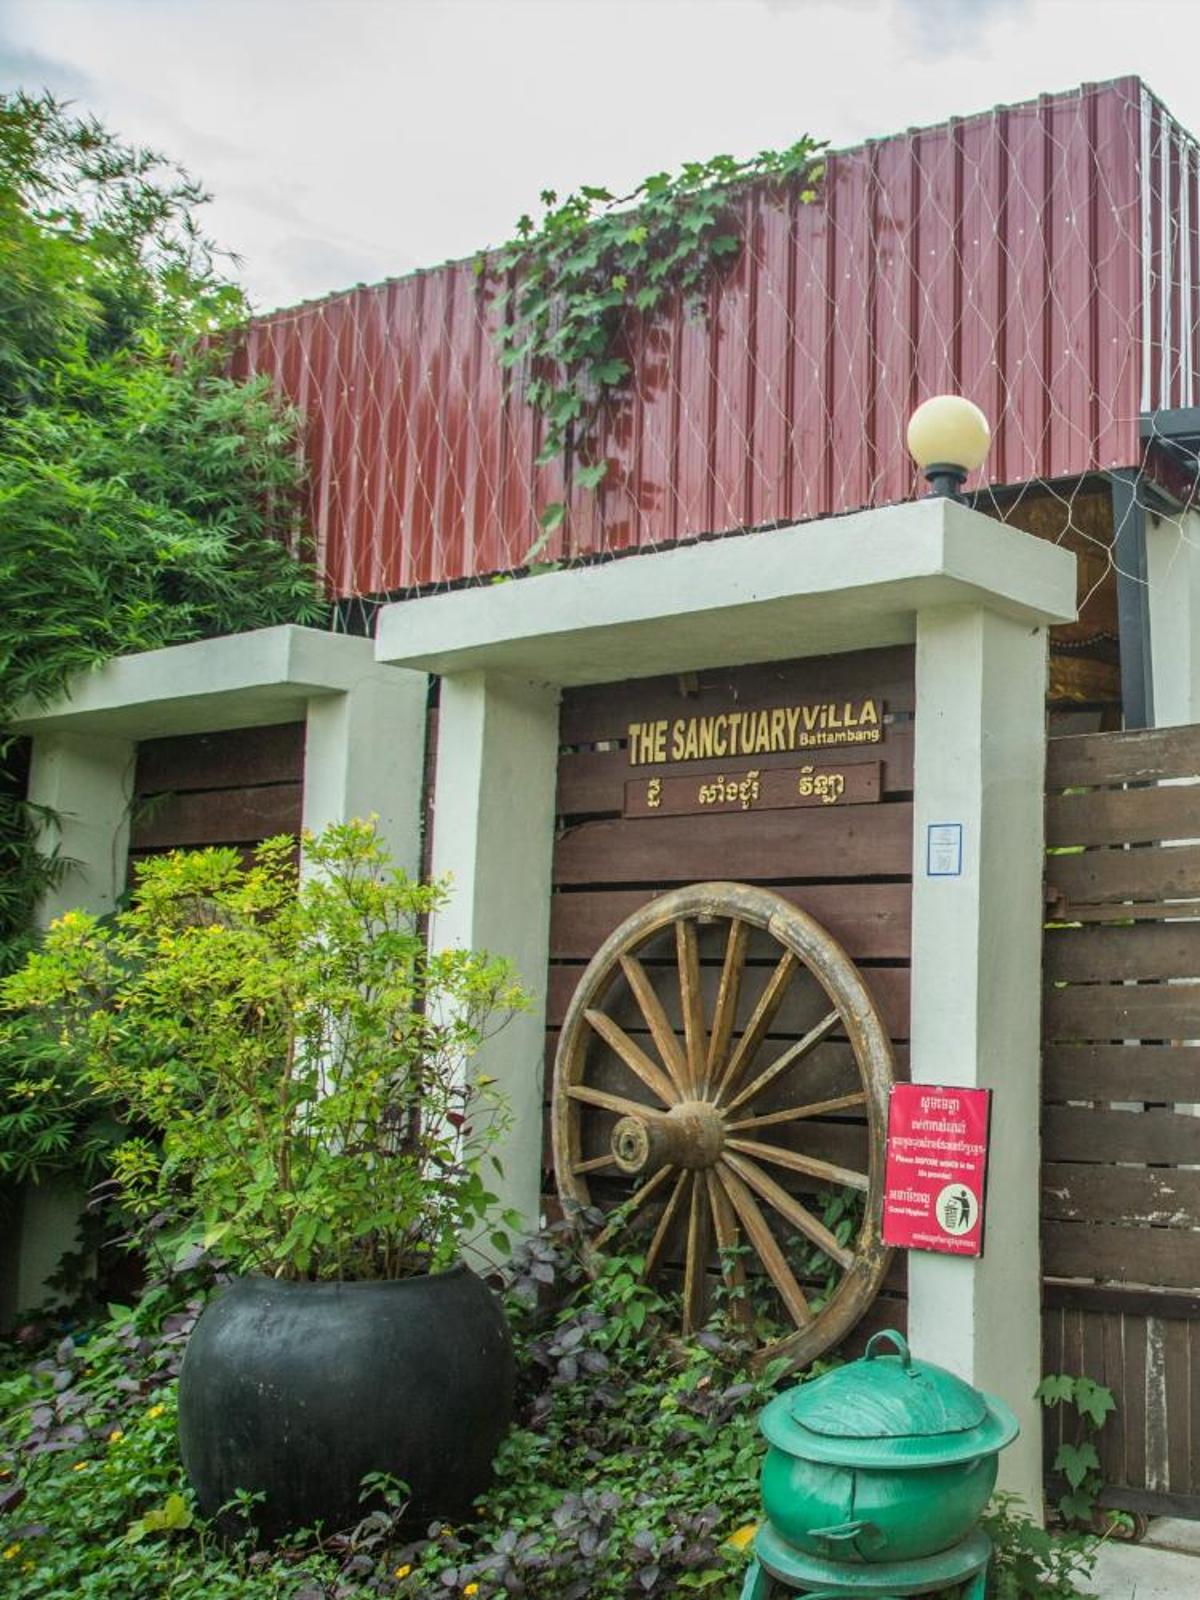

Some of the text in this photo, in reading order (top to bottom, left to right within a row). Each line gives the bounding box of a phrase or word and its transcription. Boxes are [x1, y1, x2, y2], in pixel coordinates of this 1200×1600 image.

[628, 720, 668, 765] THE
[672, 707, 800, 761] SANCTUARY
[800, 729, 881, 746] Battambang
